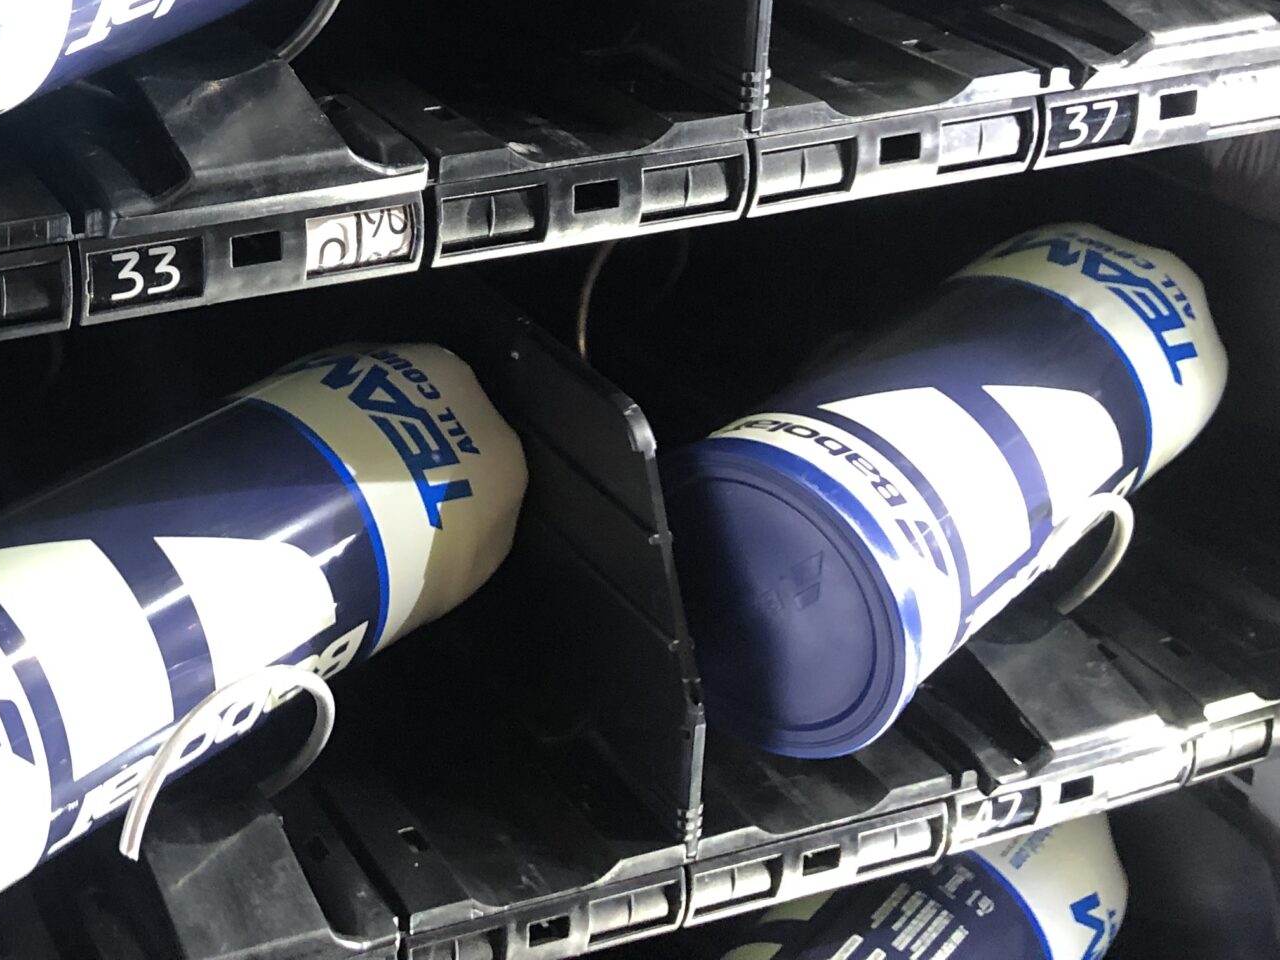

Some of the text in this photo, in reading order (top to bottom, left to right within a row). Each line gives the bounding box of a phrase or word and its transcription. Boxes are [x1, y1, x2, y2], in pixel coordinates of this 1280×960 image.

[1059, 99, 1119, 150] 37
[110, 244, 183, 302] 33
[437, 406, 481, 455] ALL
